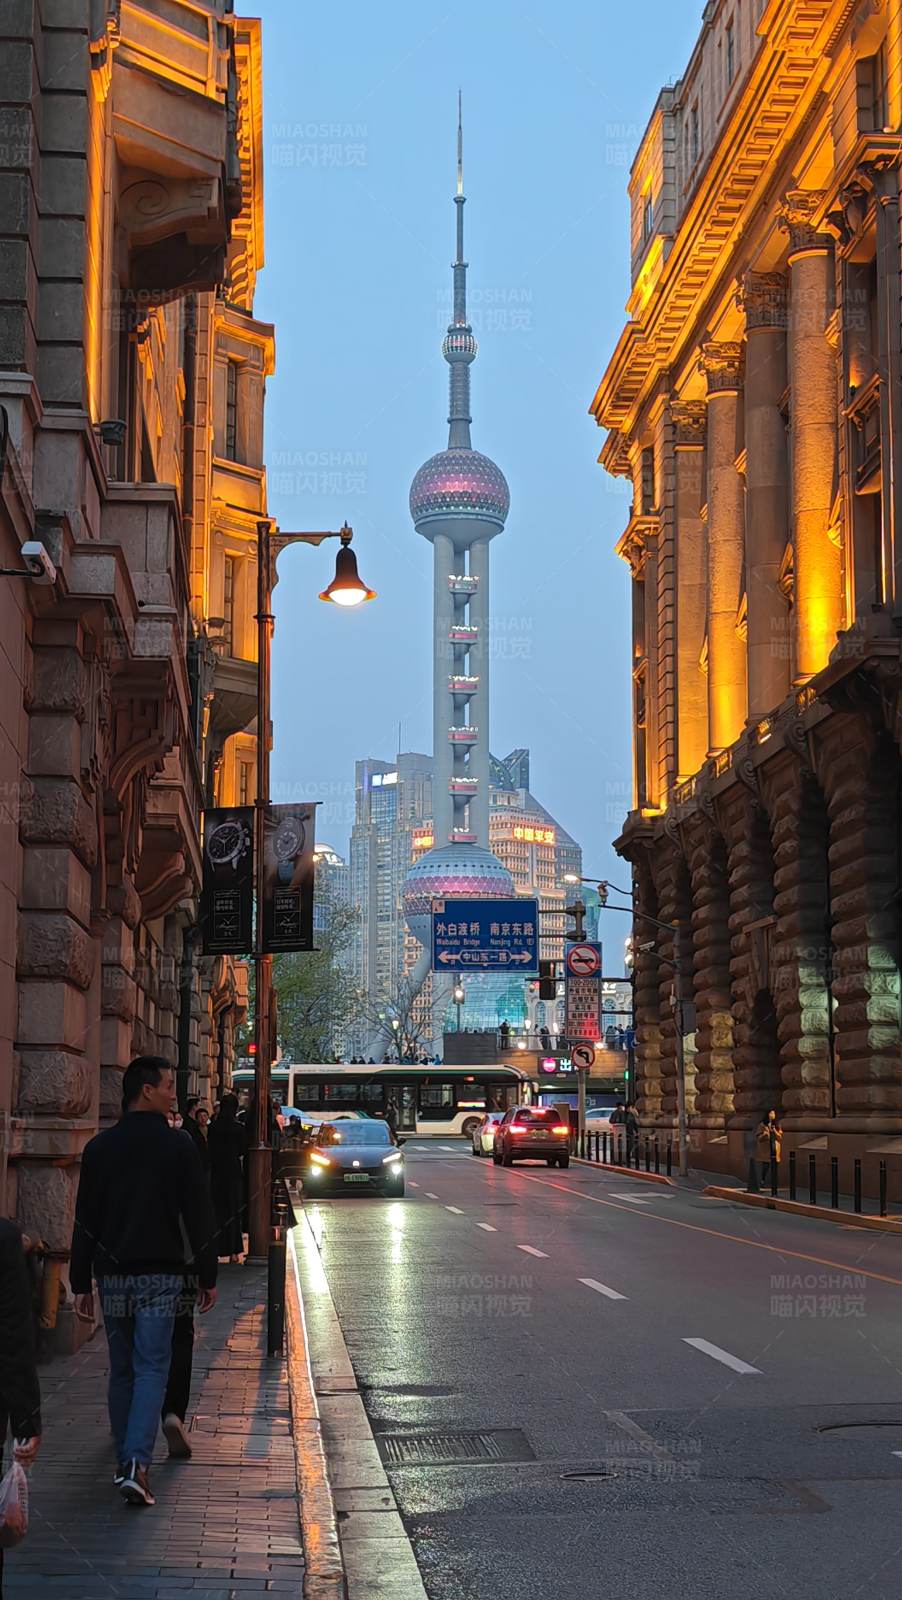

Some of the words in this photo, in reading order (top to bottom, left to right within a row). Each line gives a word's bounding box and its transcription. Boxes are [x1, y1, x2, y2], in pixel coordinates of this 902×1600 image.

[513, 828, 555, 844] 中国平安
[436, 921, 480, 936] 外白渡桥
[490, 921, 534, 936] 南京东路
[490, 938, 510, 947] Nanjing
[463, 952, 507, 962] 中山东一路
